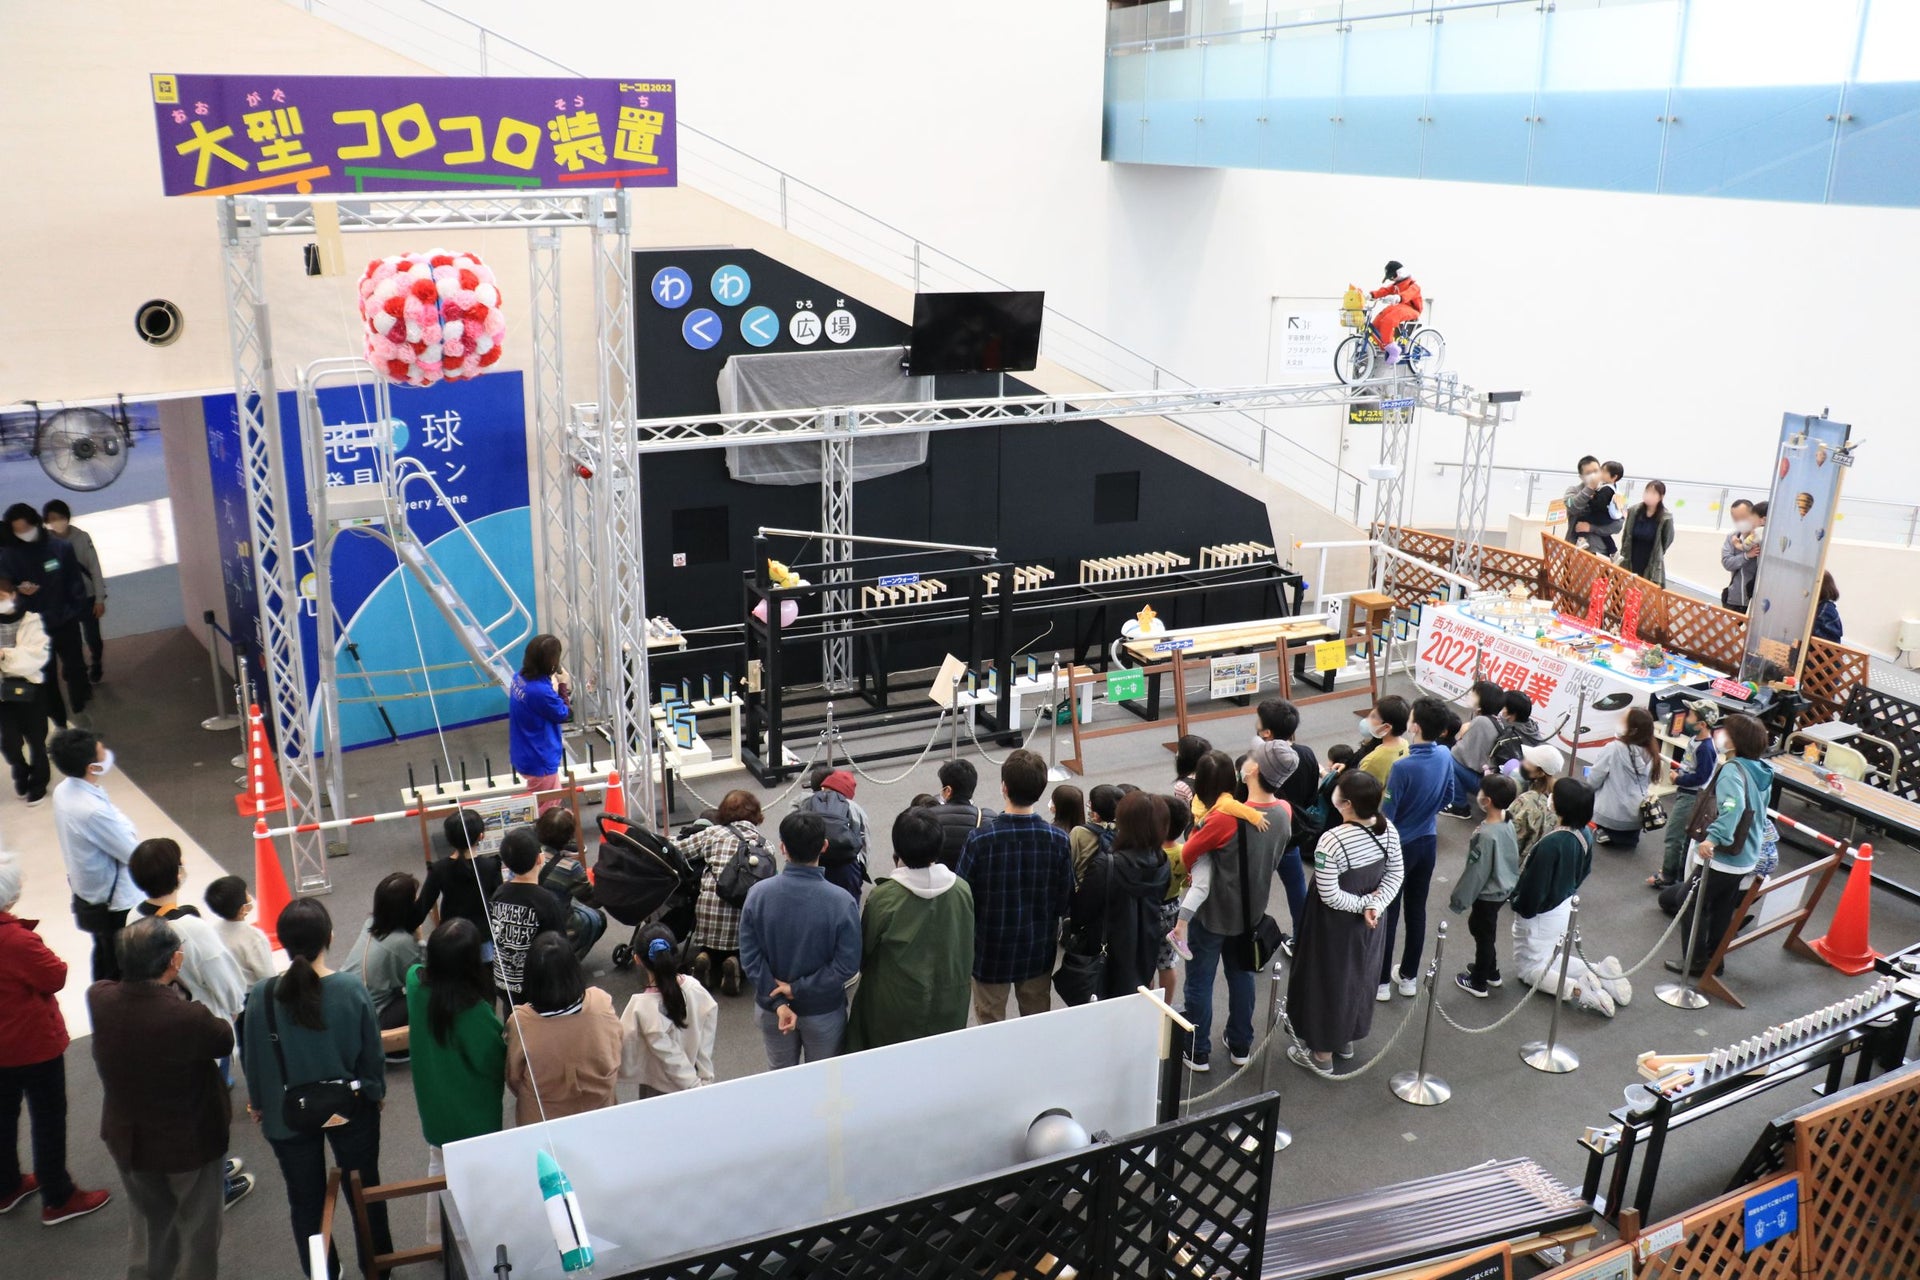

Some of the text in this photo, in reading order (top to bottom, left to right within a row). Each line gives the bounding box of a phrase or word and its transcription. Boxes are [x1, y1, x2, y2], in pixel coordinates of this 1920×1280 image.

[171, 88, 649, 125] おお がた そう ち
[795, 300, 813, 310] ひろ
[881, 575, 918, 586] ムーンウォーク
[1432, 615, 1496, 649] 西九州新幹線
[1154, 640, 1194, 653] リニアモーターカー
[1570, 667, 1604, 690] TAKEO
